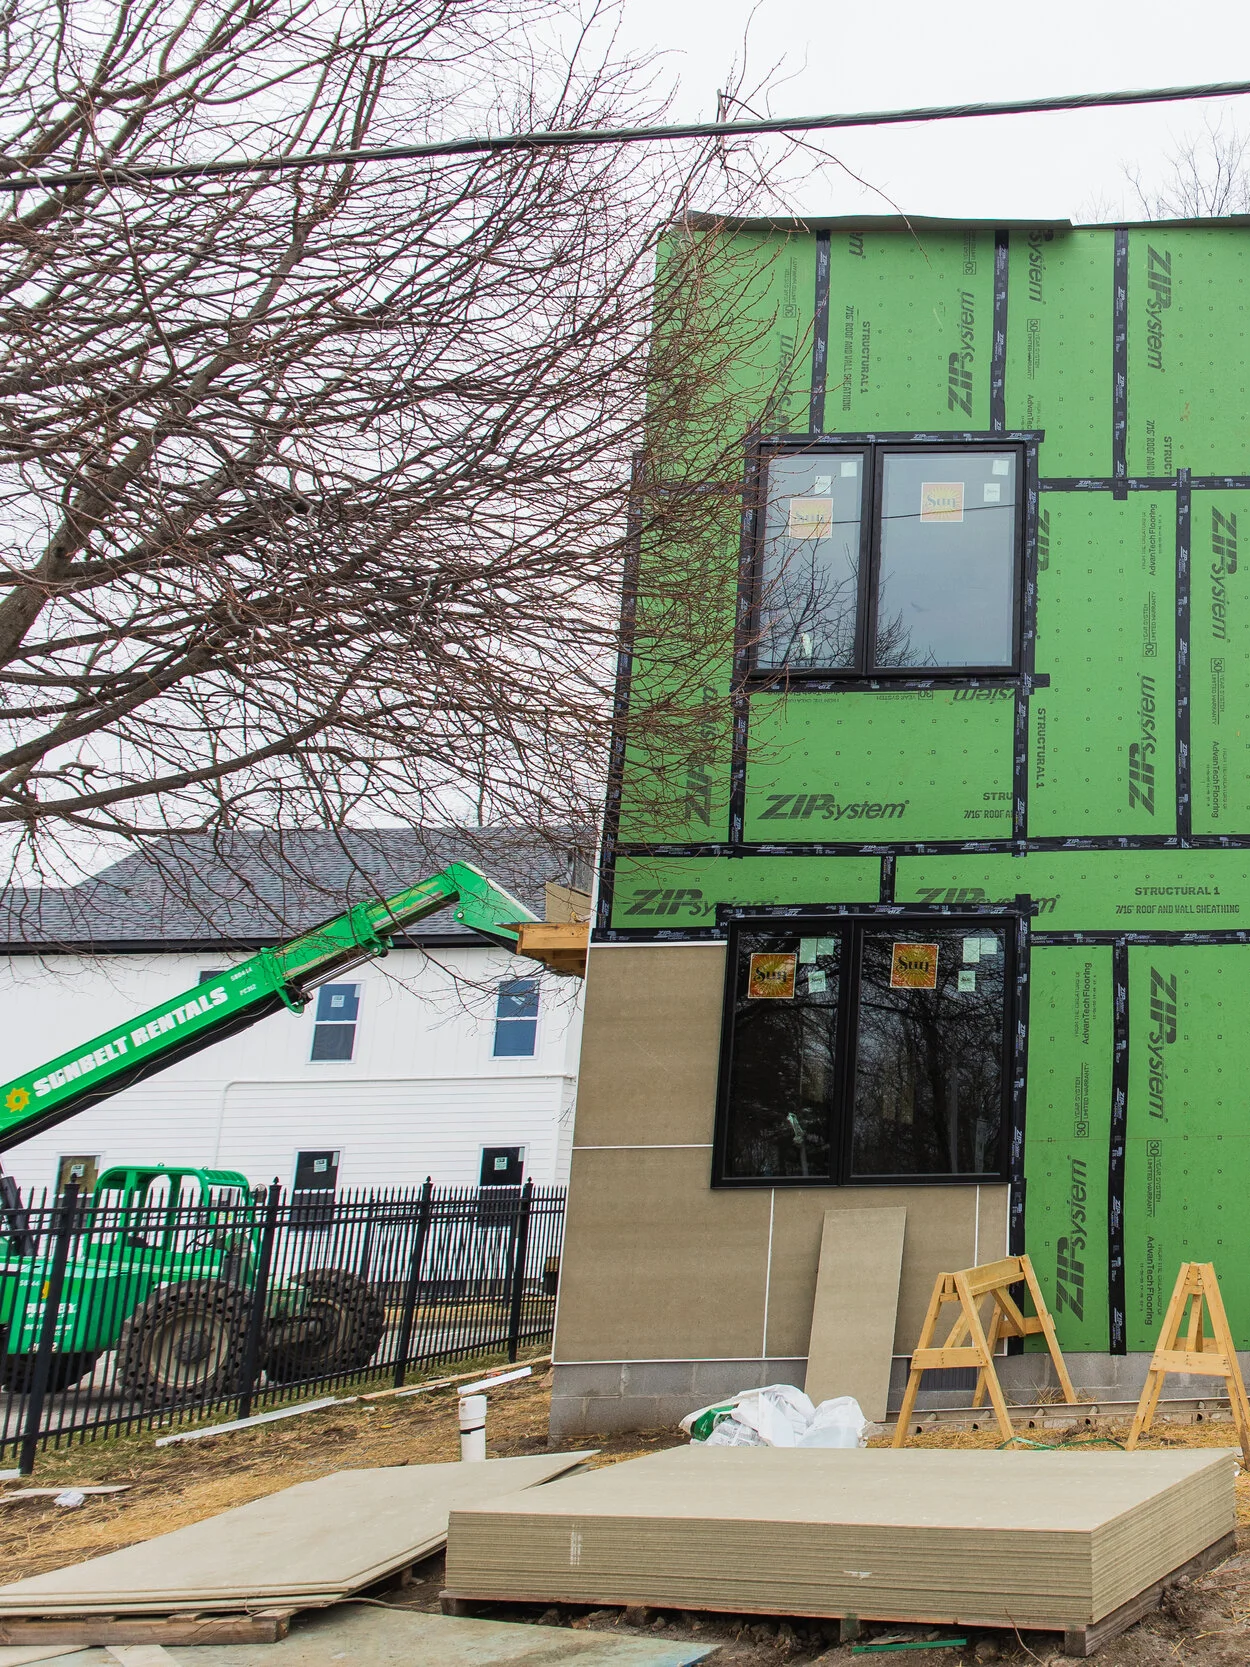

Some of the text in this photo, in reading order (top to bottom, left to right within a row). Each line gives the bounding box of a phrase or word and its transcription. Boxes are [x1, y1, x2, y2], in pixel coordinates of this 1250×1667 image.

[964, 262, 975, 274] 30
[861, 321, 870, 385] STRUCTURAL
[1149, 504, 1157, 576] AdvanTech Flooring
[1144, 644, 1156, 656] 30
[1212, 659, 1224, 671] 30
[1036, 708, 1046, 779] STRUCTURAL
[984, 810, 1003, 818] ROOF
[1135, 886, 1220, 896] STRUCTURAL 1
[1082, 963, 1092, 1044] AdvanTech Flooring
[33, 986, 228, 1098] SUNBELT RENTALS
[1075, 1122, 1088, 1137] 30
[1148, 1141, 1161, 1155] 30
[1145, 1236, 1154, 1325] AdvanTech Flooring
